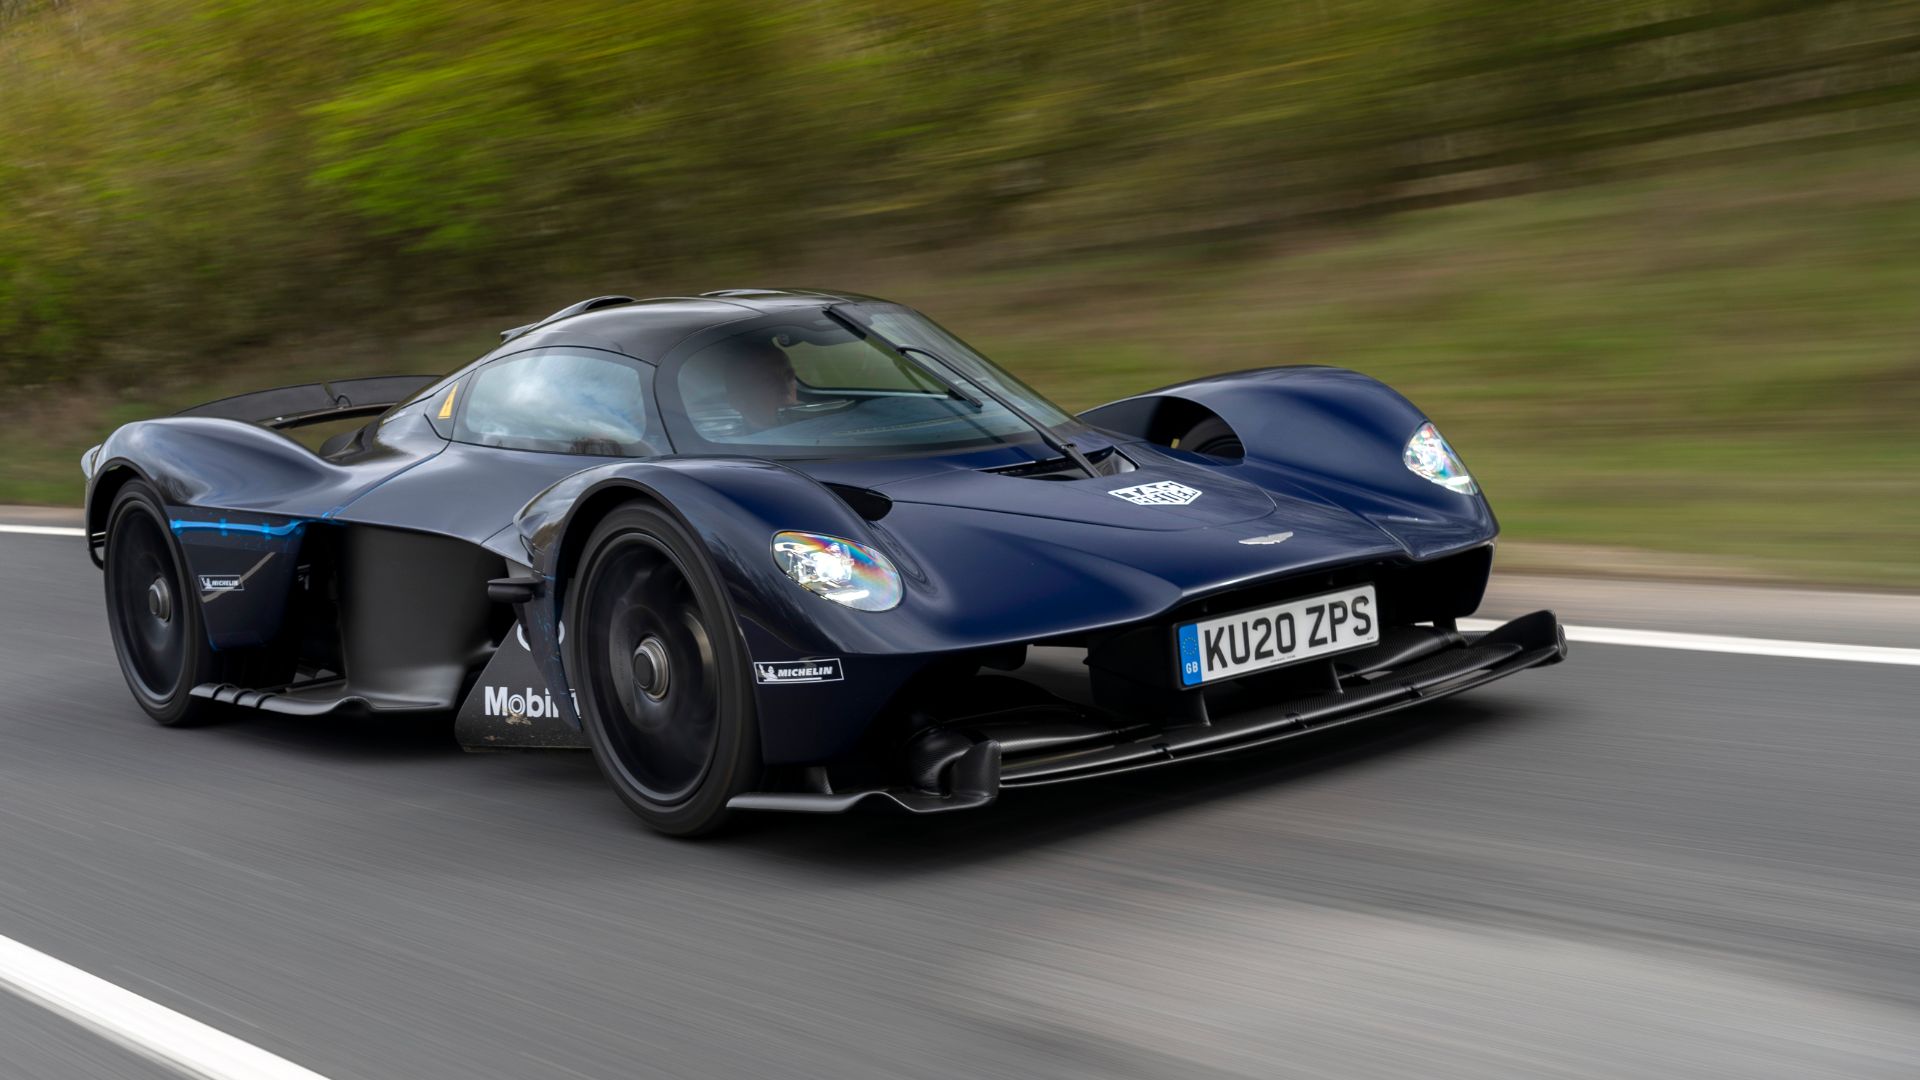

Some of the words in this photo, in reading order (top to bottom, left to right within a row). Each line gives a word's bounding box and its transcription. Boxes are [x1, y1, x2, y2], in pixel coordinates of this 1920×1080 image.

[1204, 612, 1296, 672] KU20
[1305, 595, 1371, 648] ZPS
[777, 666, 833, 677] MICHELIN
[1185, 661, 1198, 674] GB
